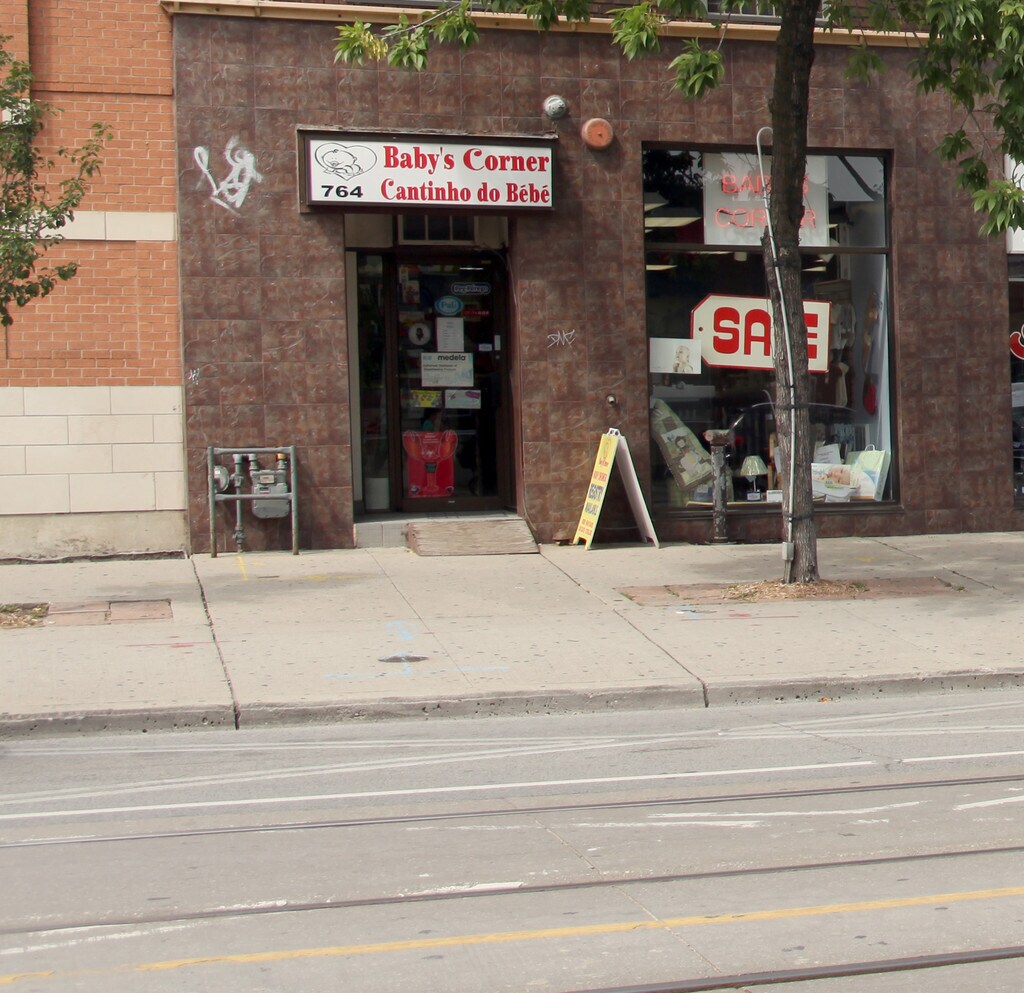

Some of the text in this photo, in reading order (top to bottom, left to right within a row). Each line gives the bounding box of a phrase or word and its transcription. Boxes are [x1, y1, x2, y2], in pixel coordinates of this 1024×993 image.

[383, 145, 550, 174] Baby's Corner
[321, 177, 550, 204] 764 Cantinho do Bébé
[712, 306, 819, 359] SAE
[437, 353, 466, 362] medela
